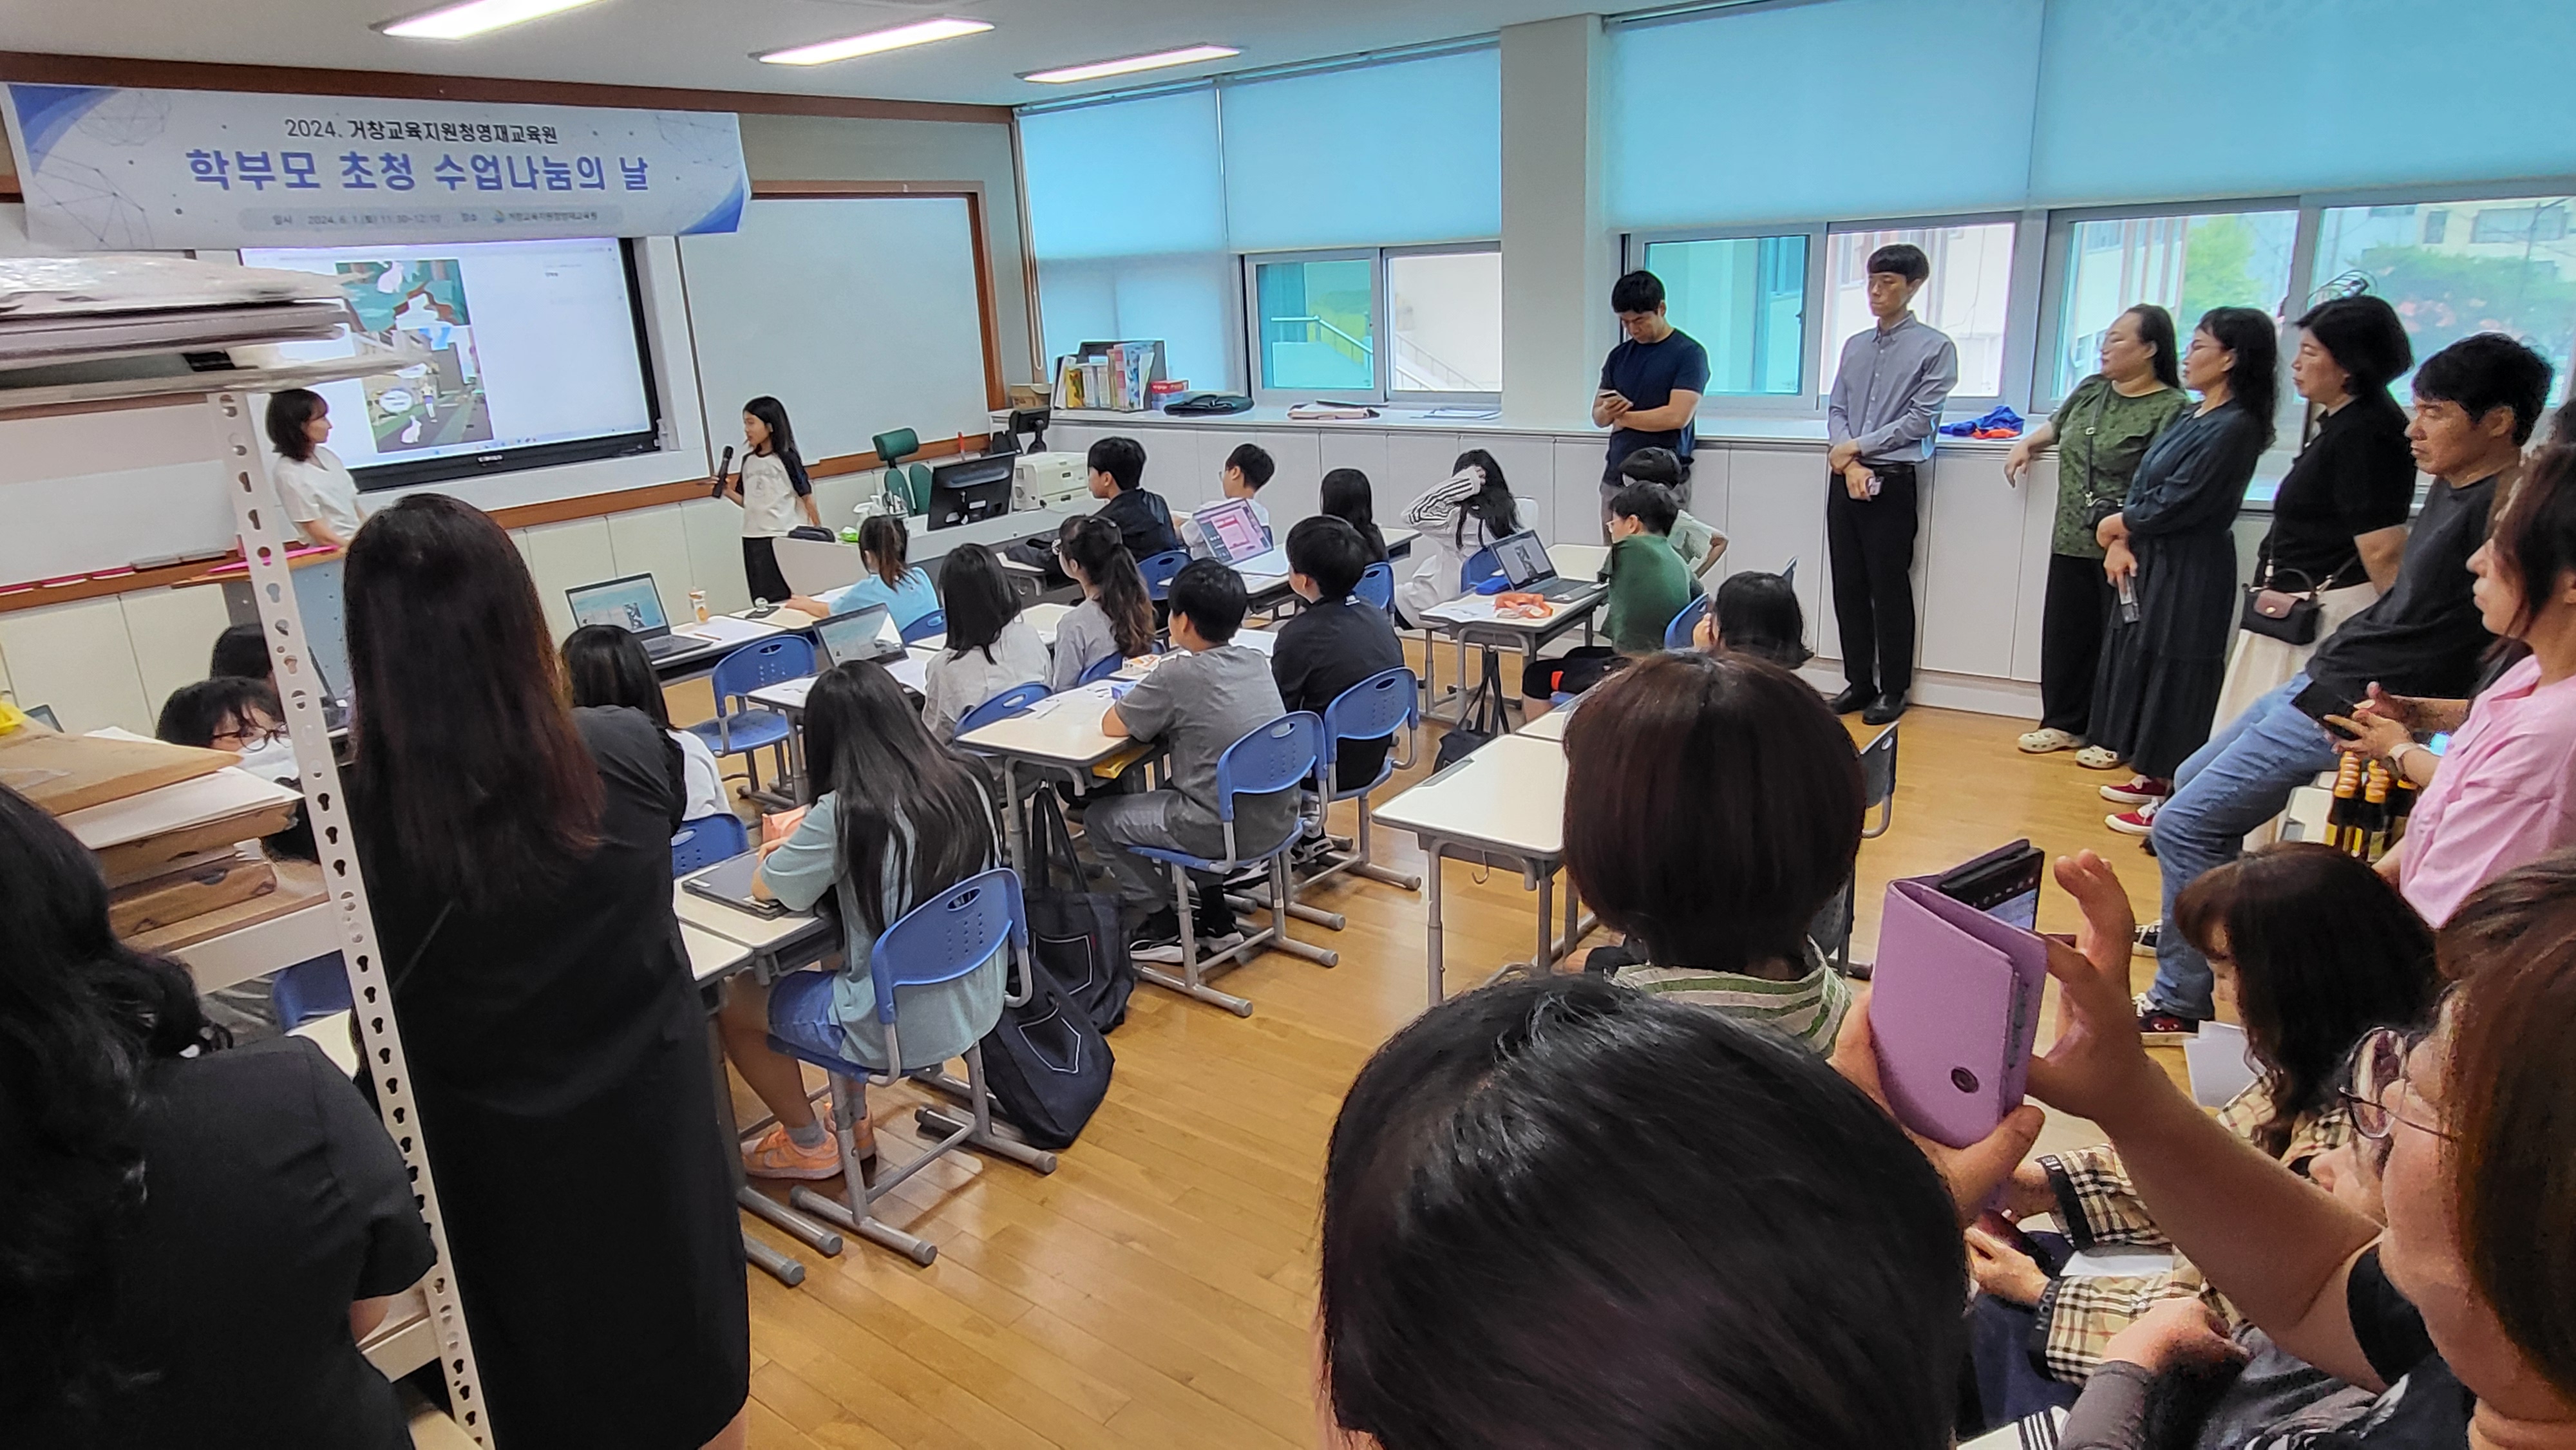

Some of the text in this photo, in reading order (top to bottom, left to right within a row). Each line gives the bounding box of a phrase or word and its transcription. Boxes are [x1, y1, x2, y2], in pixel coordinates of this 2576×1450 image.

[285, 118, 558, 144] 2024. 거창교육지원청영재교육원
[185, 149, 649, 191] 학부모 초청 수업나눔의 날
